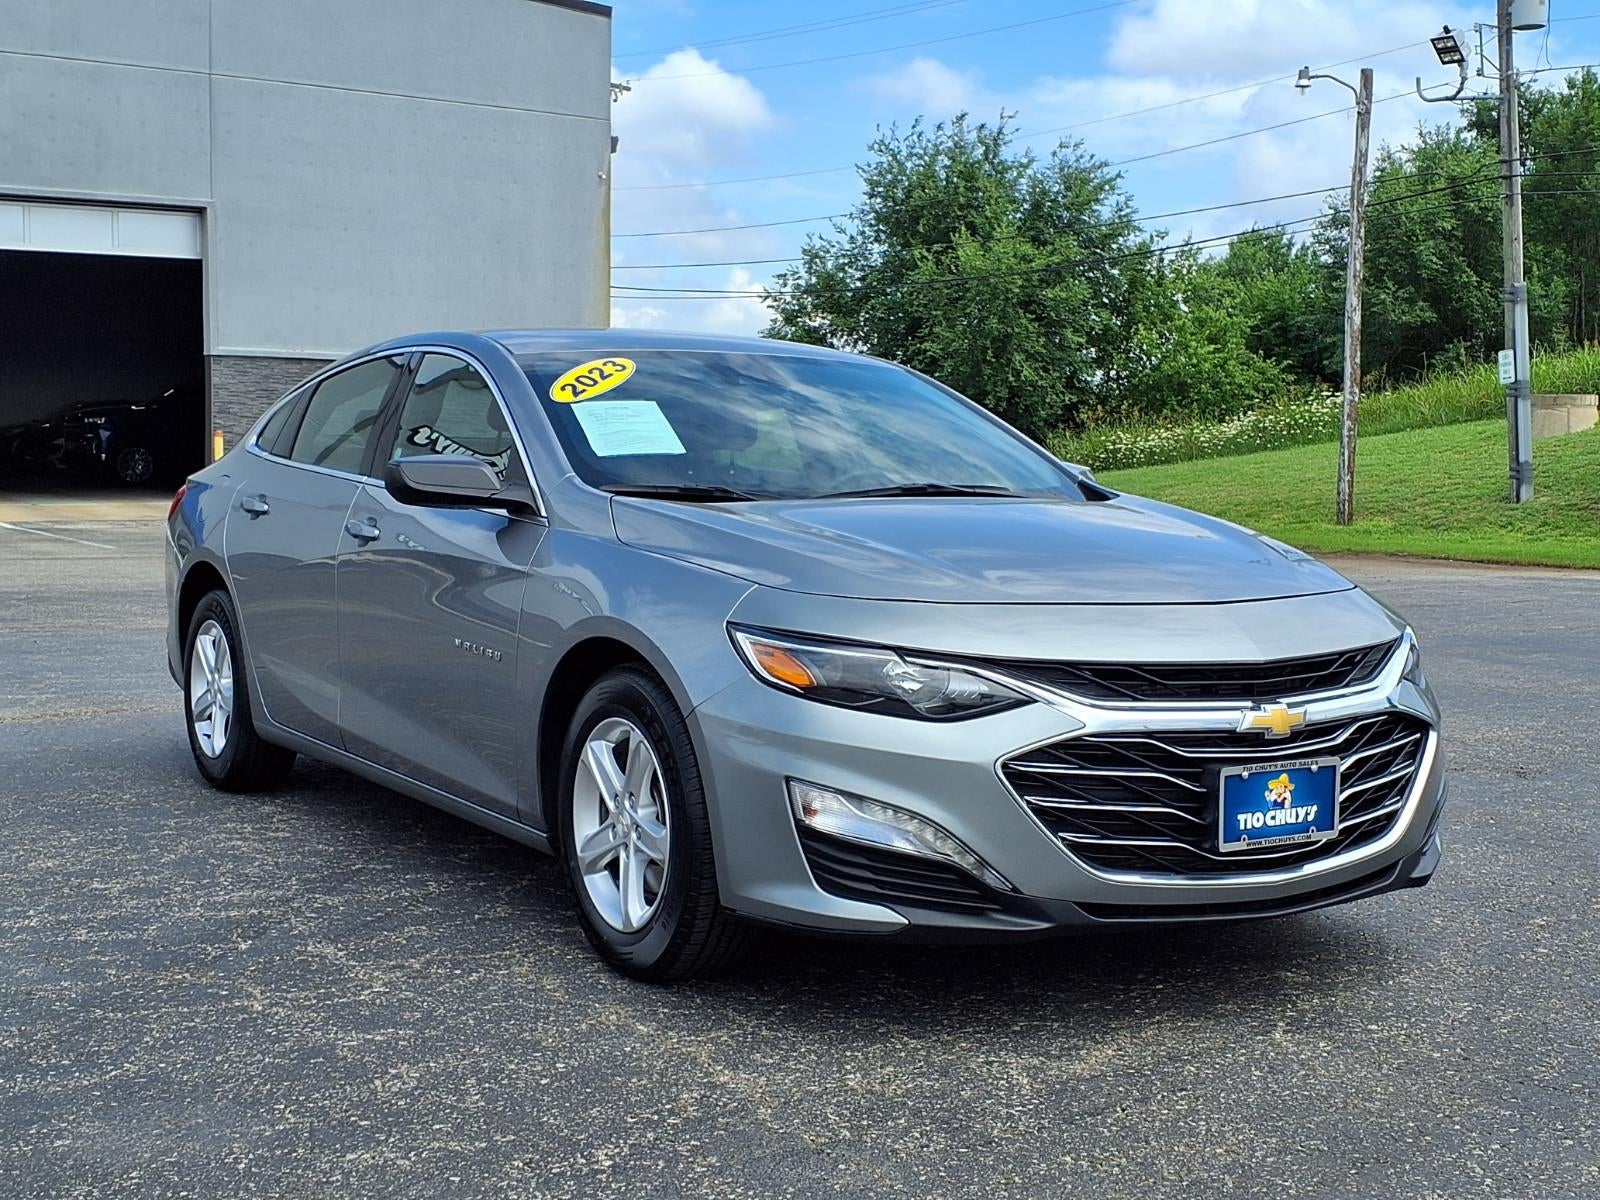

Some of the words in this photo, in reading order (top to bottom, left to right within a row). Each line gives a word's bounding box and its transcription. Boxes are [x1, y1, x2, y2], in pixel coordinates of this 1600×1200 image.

[560, 360, 627, 398] 2023
[454, 638, 502, 662] MALIBU
[1254, 763, 1278, 771] CHUY'S
[1280, 761, 1297, 769] AUTO
[1246, 834, 1312, 848] WWW.TIOCHUYS.COM
